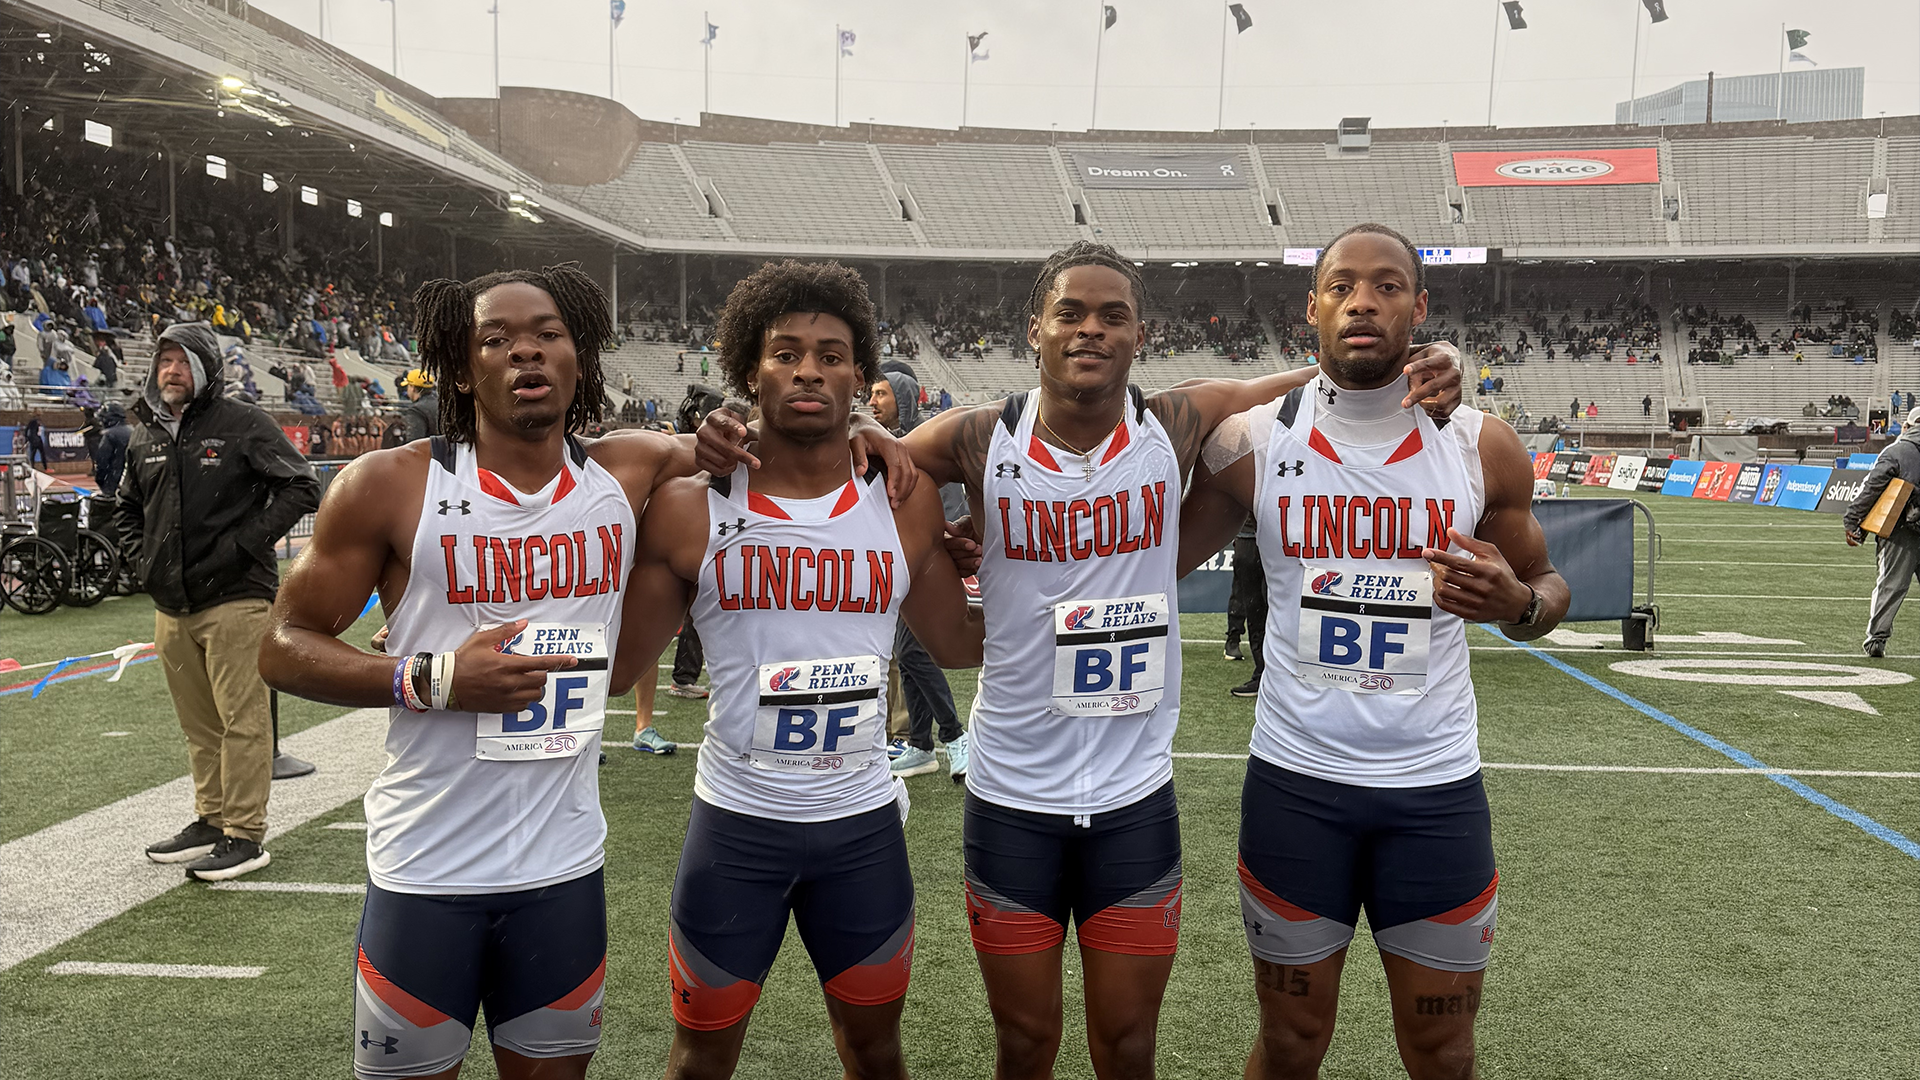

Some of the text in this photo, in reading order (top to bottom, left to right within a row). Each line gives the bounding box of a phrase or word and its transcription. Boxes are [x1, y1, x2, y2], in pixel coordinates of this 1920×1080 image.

[1088, 166, 1188, 178] Dream On.
[1512, 165, 1597, 174] Grace
[1786, 480, 1815, 493] Independence
[998, 480, 1166, 563] LINCOLN
[1278, 495, 1455, 560] LINCOLN
[440, 523, 623, 605] LINCOLN
[714, 544, 894, 614] LINCOLN
[1353, 573, 1404, 588] PENN
[1349, 587, 1418, 602] RELAYS
[1103, 601, 1146, 616] PENN
[1101, 612, 1158, 628] RELAYS
[534, 628, 581, 642] PENN
[1318, 615, 1409, 670] BF
[532, 642, 593, 655] RELAYS
[810, 662, 856, 677] PENN
[1073, 642, 1149, 693] BF
[807, 673, 869, 690] RELAYS
[1321, 672, 1395, 690] AMERICA 250
[1075, 695, 1140, 711] AMERICA 250
[773, 705, 860, 753] BF
[504, 734, 578, 753] AMERICA 250
[774, 755, 844, 770] AMERICA 250
